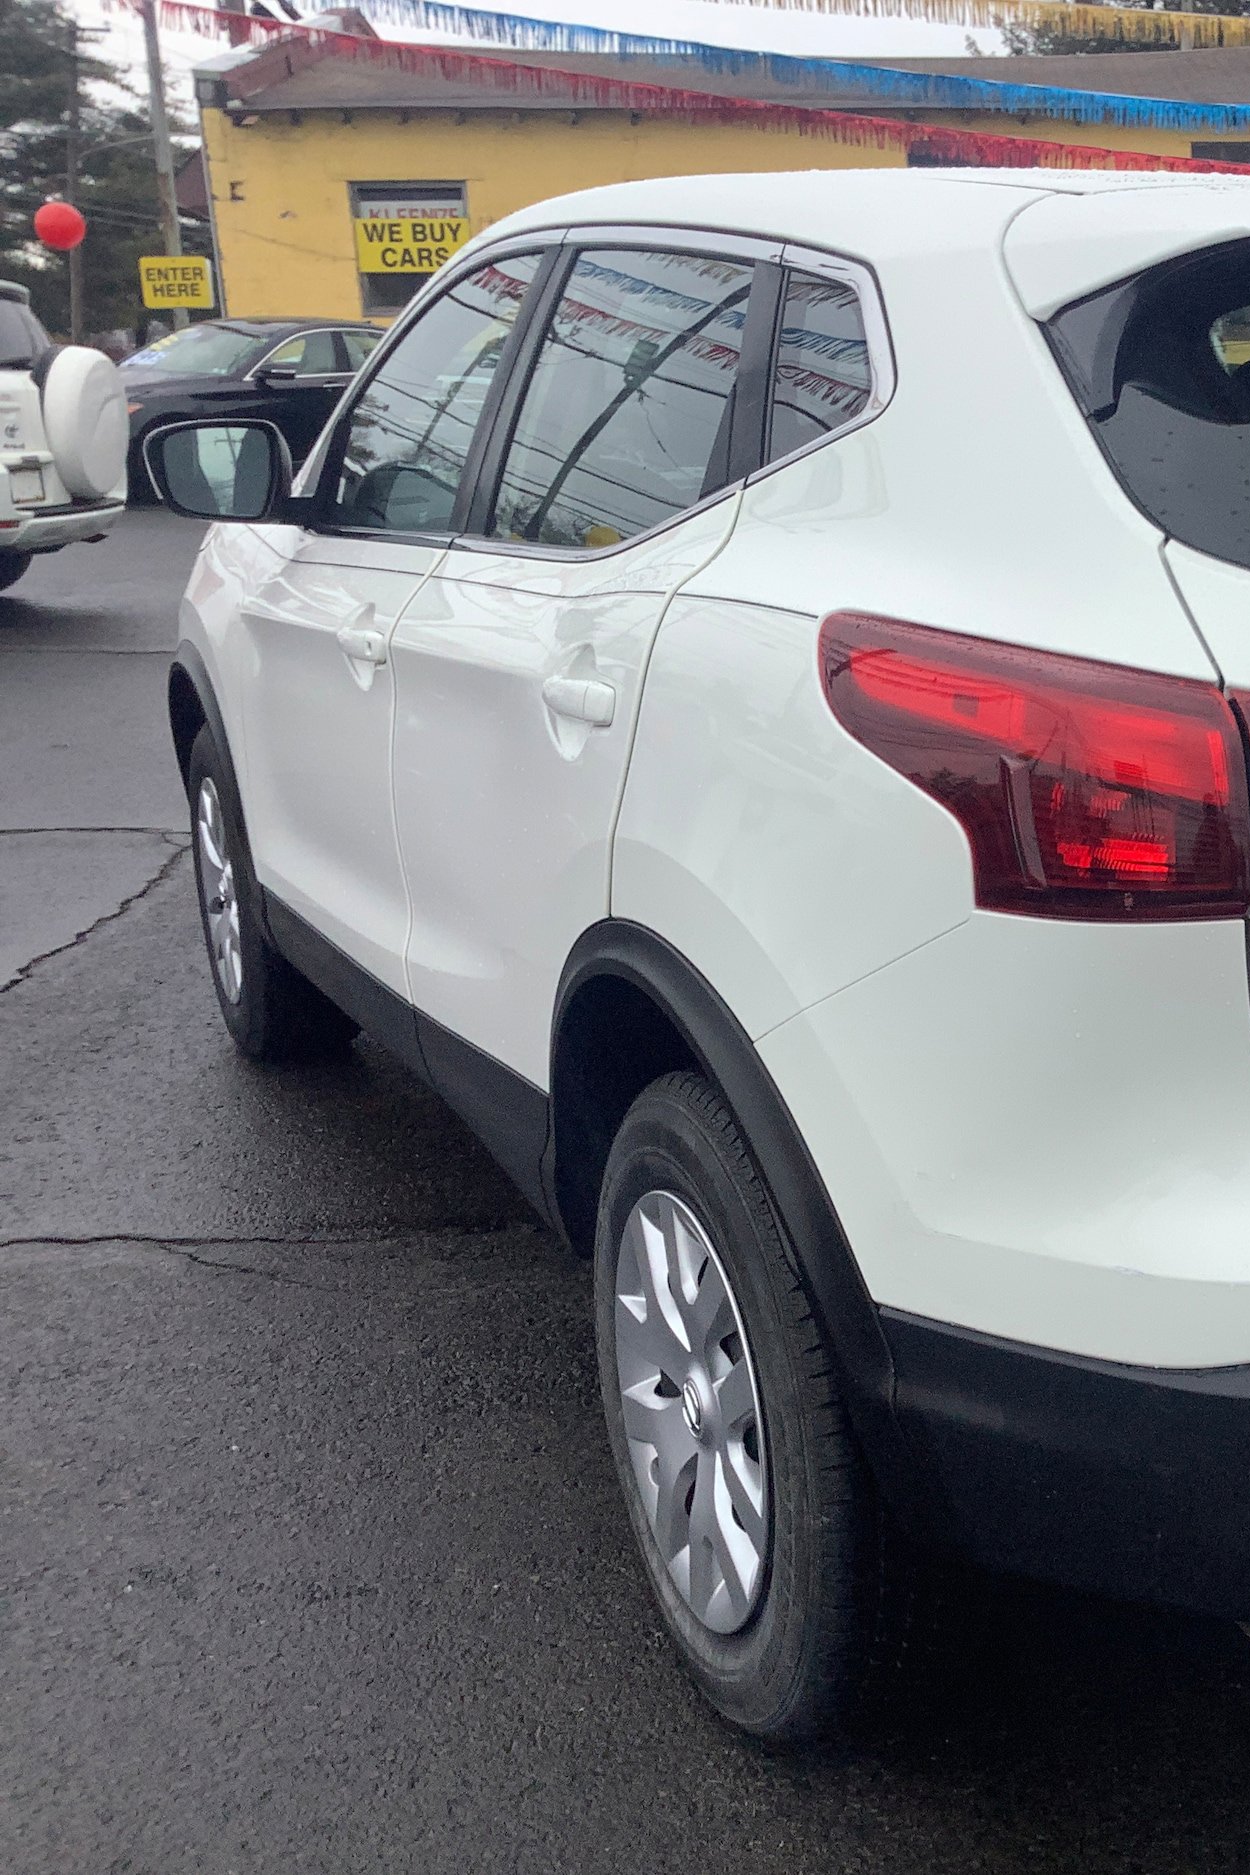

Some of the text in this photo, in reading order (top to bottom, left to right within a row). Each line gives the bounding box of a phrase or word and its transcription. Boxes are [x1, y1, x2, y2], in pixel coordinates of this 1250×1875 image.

[362, 223, 462, 243] WE BUY
[380, 247, 450, 268] CARS
[145, 266, 205, 282] ENTER
[152, 282, 202, 298] HERE
